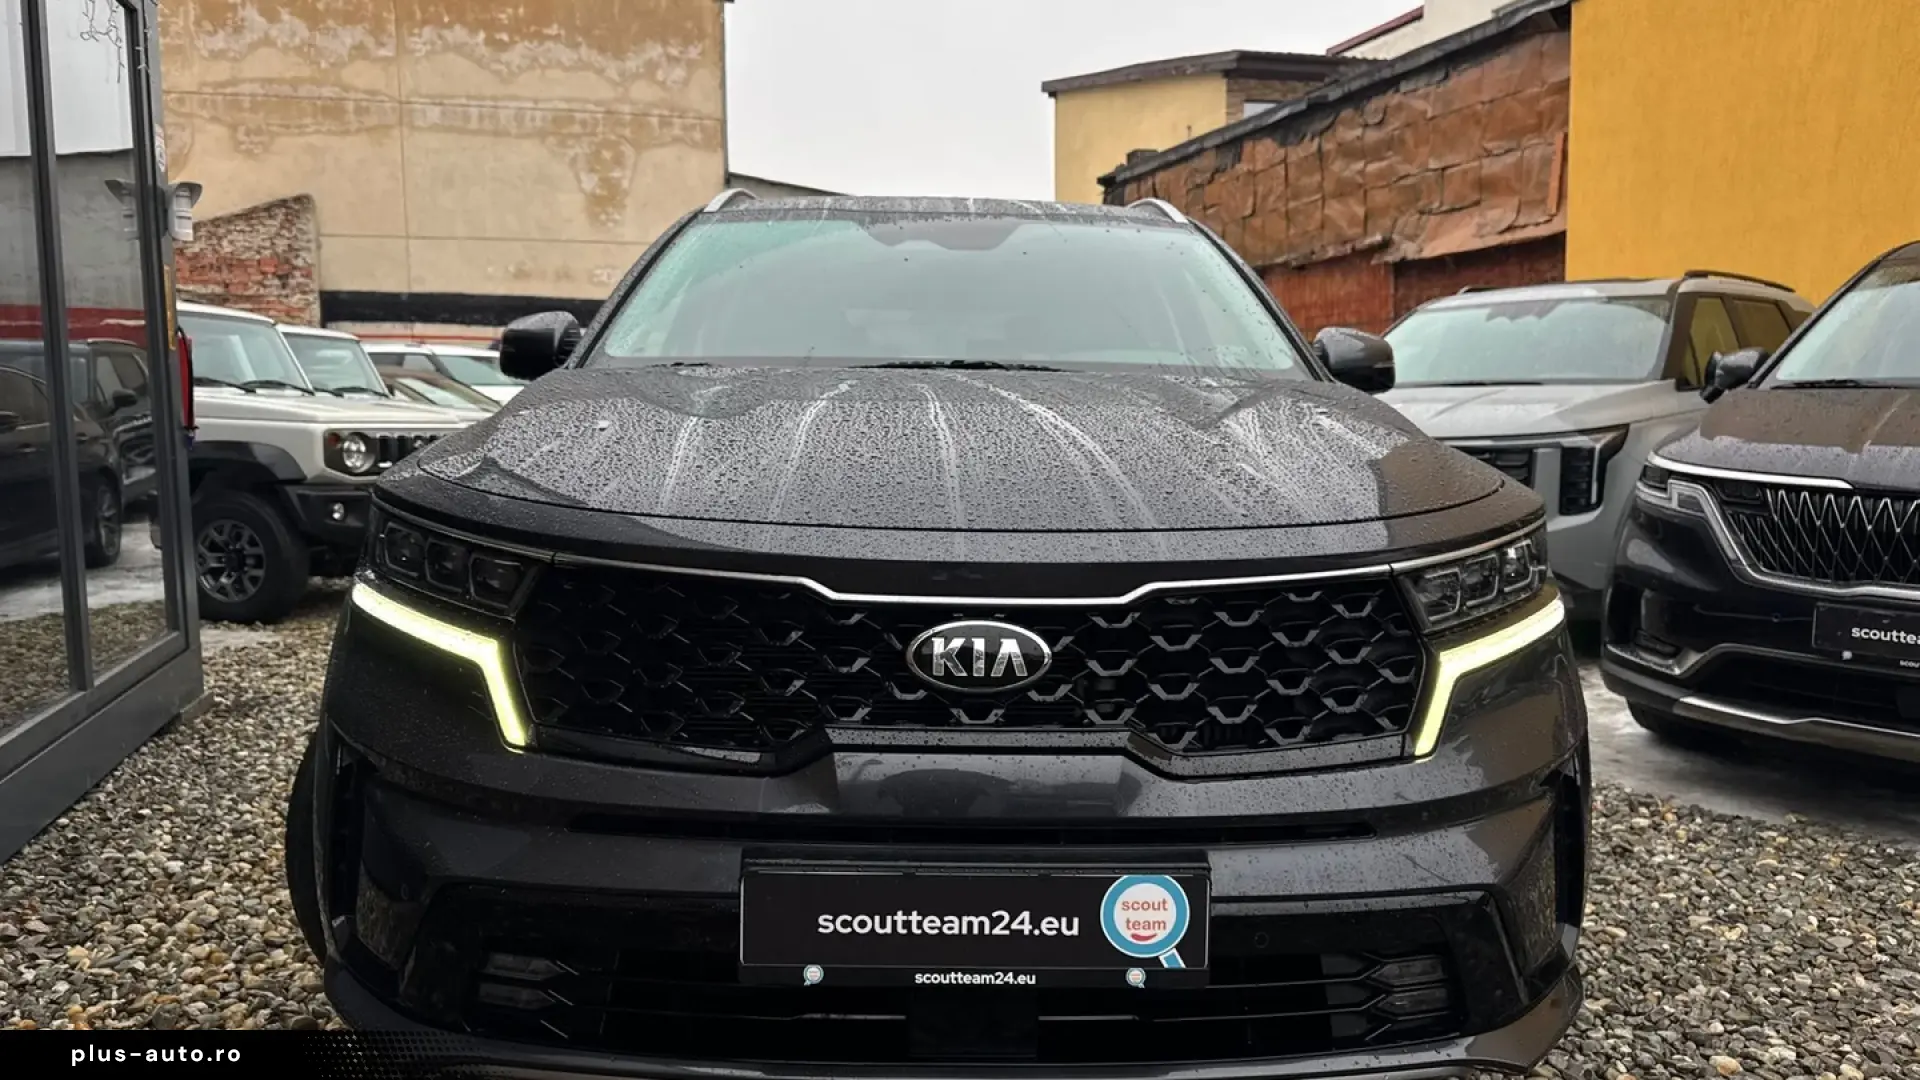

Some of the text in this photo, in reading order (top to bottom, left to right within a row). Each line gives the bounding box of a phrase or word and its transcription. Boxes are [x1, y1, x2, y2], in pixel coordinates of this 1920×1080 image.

[931, 636, 1029, 677] KIA
[1121, 898, 1168, 912] scout
[817, 910, 1080, 937] scoutteam24.eu
[1125, 917, 1167, 931] team
[914, 971, 1037, 985] scoutteam24.eu
